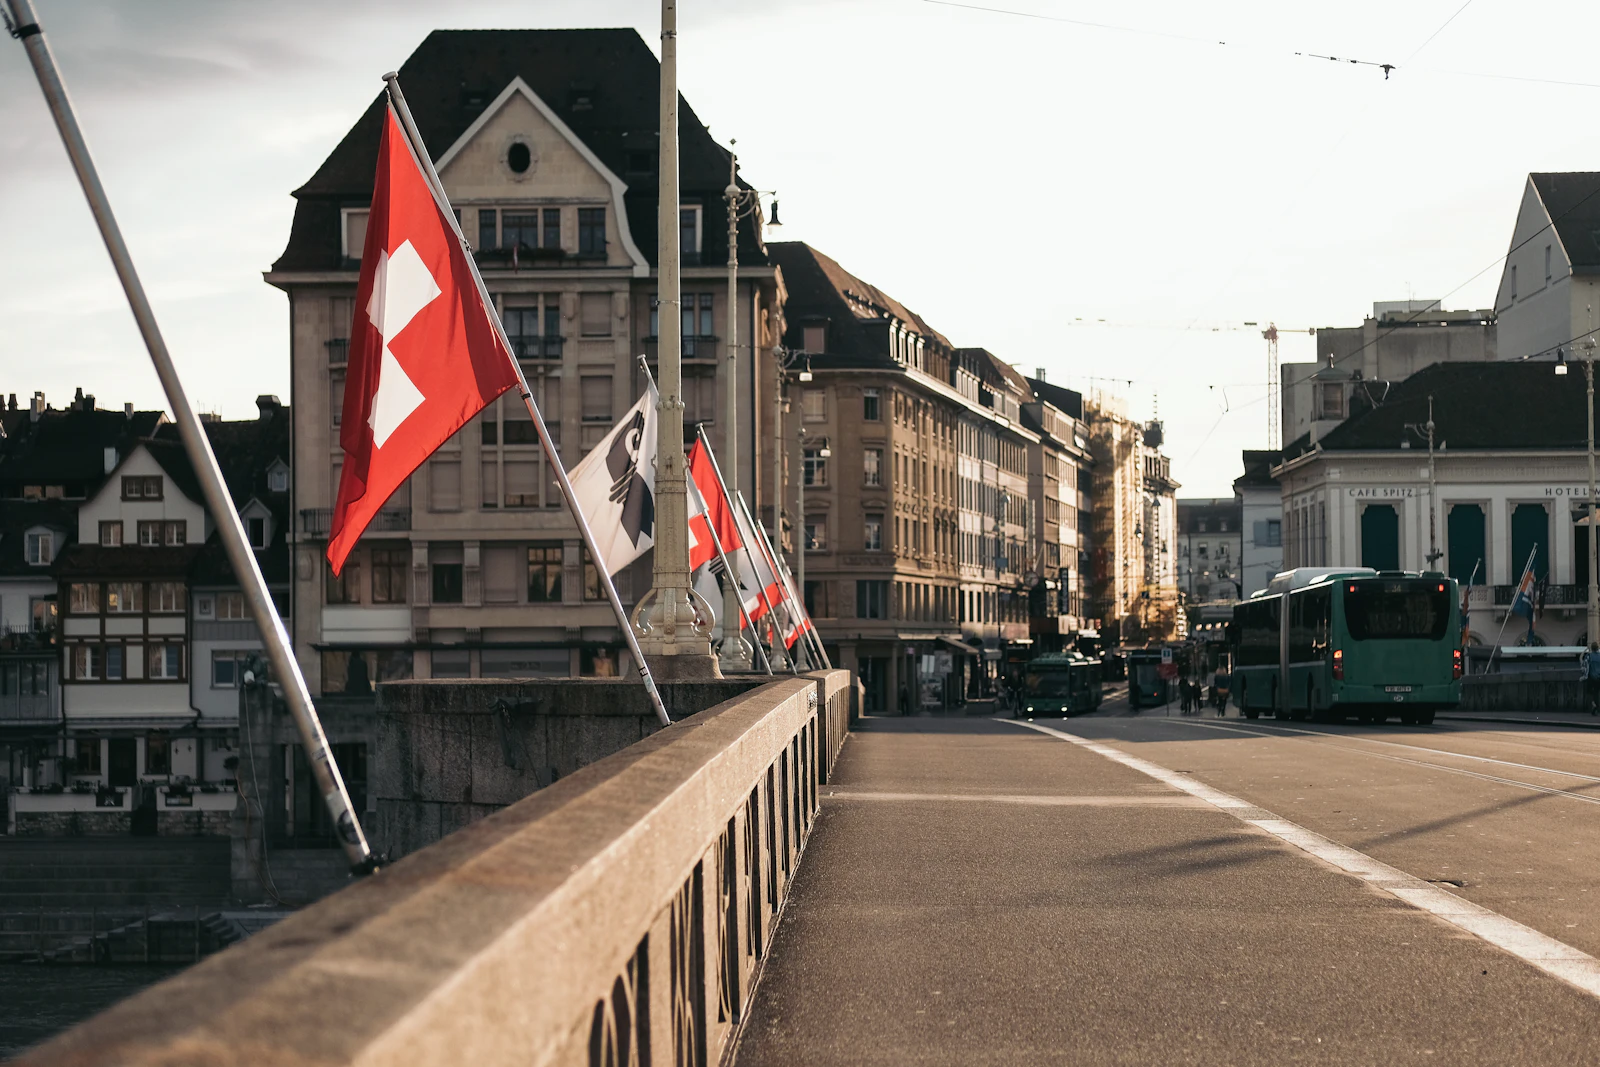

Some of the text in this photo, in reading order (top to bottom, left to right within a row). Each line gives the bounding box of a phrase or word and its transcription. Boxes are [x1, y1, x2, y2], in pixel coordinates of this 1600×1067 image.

[1349, 488, 1413, 497] CAFE SPITZ
[1545, 487, 1588, 496] HOTEL
